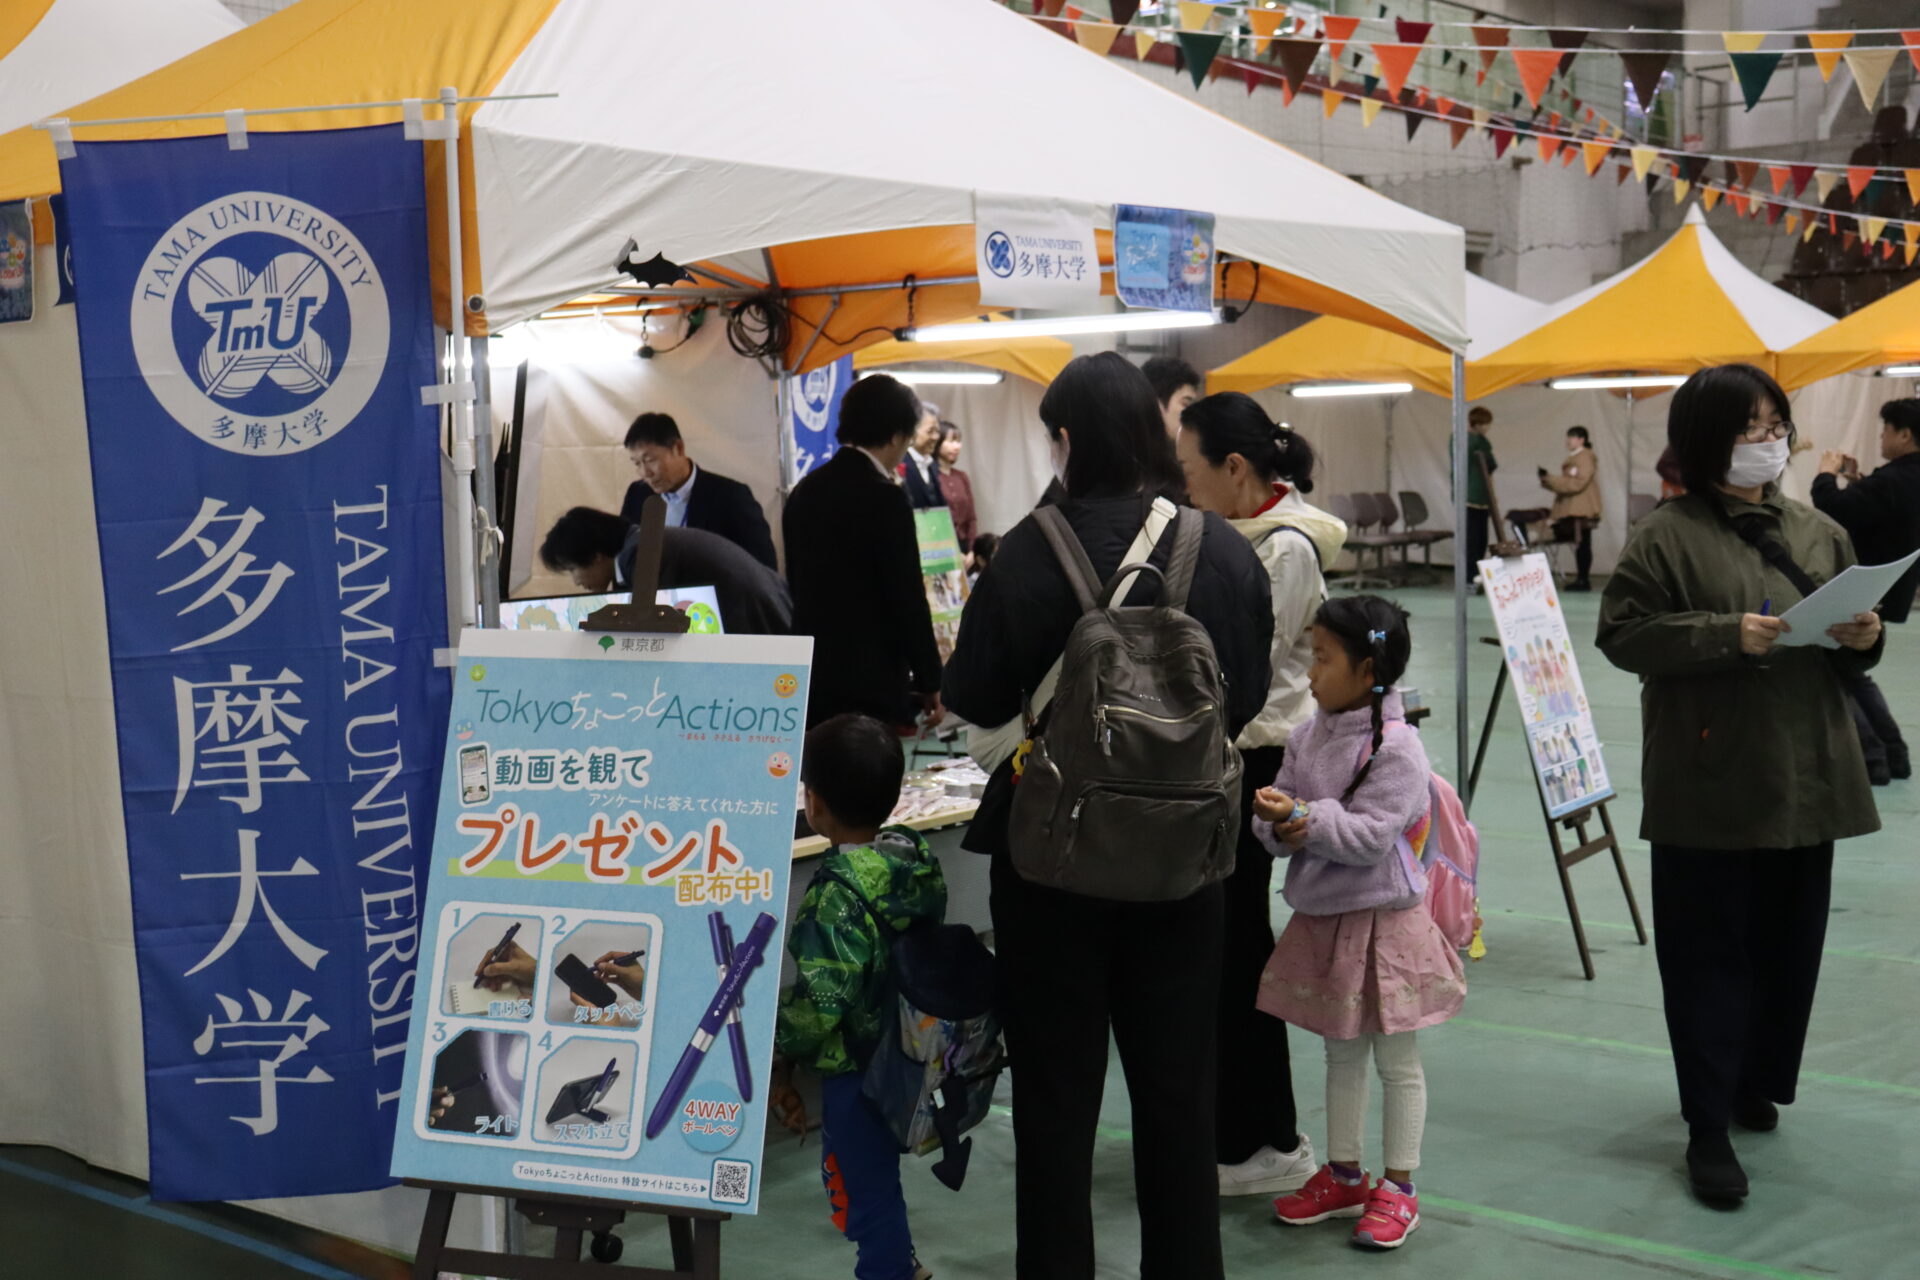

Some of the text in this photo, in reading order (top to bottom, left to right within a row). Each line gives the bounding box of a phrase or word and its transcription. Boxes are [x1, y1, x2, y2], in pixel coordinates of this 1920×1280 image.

[144, 200, 373, 302] TAMA UNIVERSITY
[1015, 235, 1039, 248] TAMA
[1019, 251, 1087, 281] 多摩大学
[211, 408, 329, 450] 多摩大学
[333, 484, 397, 701] TAMA
[621, 638, 665, 652] 東京都
[494, 752, 648, 786] 動画を観て
[588, 793, 779, 815] アンケートに答えてくれた方に
[157, 496, 335, 1136] 多摩大学
[461, 808, 739, 879] プレゼント
[452, 908, 461, 927] 1
[551, 915, 567, 935] 2
[488, 1000, 533, 1018] 書ける
[574, 1002, 649, 1023] タッチペン
[432, 1022, 446, 1042] 3
[537, 1031, 553, 1051] 4
[684, 1099, 740, 1120] 4WAY
[474, 1115, 520, 1134] ライト
[553, 1122, 631, 1141] スマホ立て
[682, 1121, 737, 1135] ボールペン
[621, 1176, 698, 1193] 特設サイトはこちら
